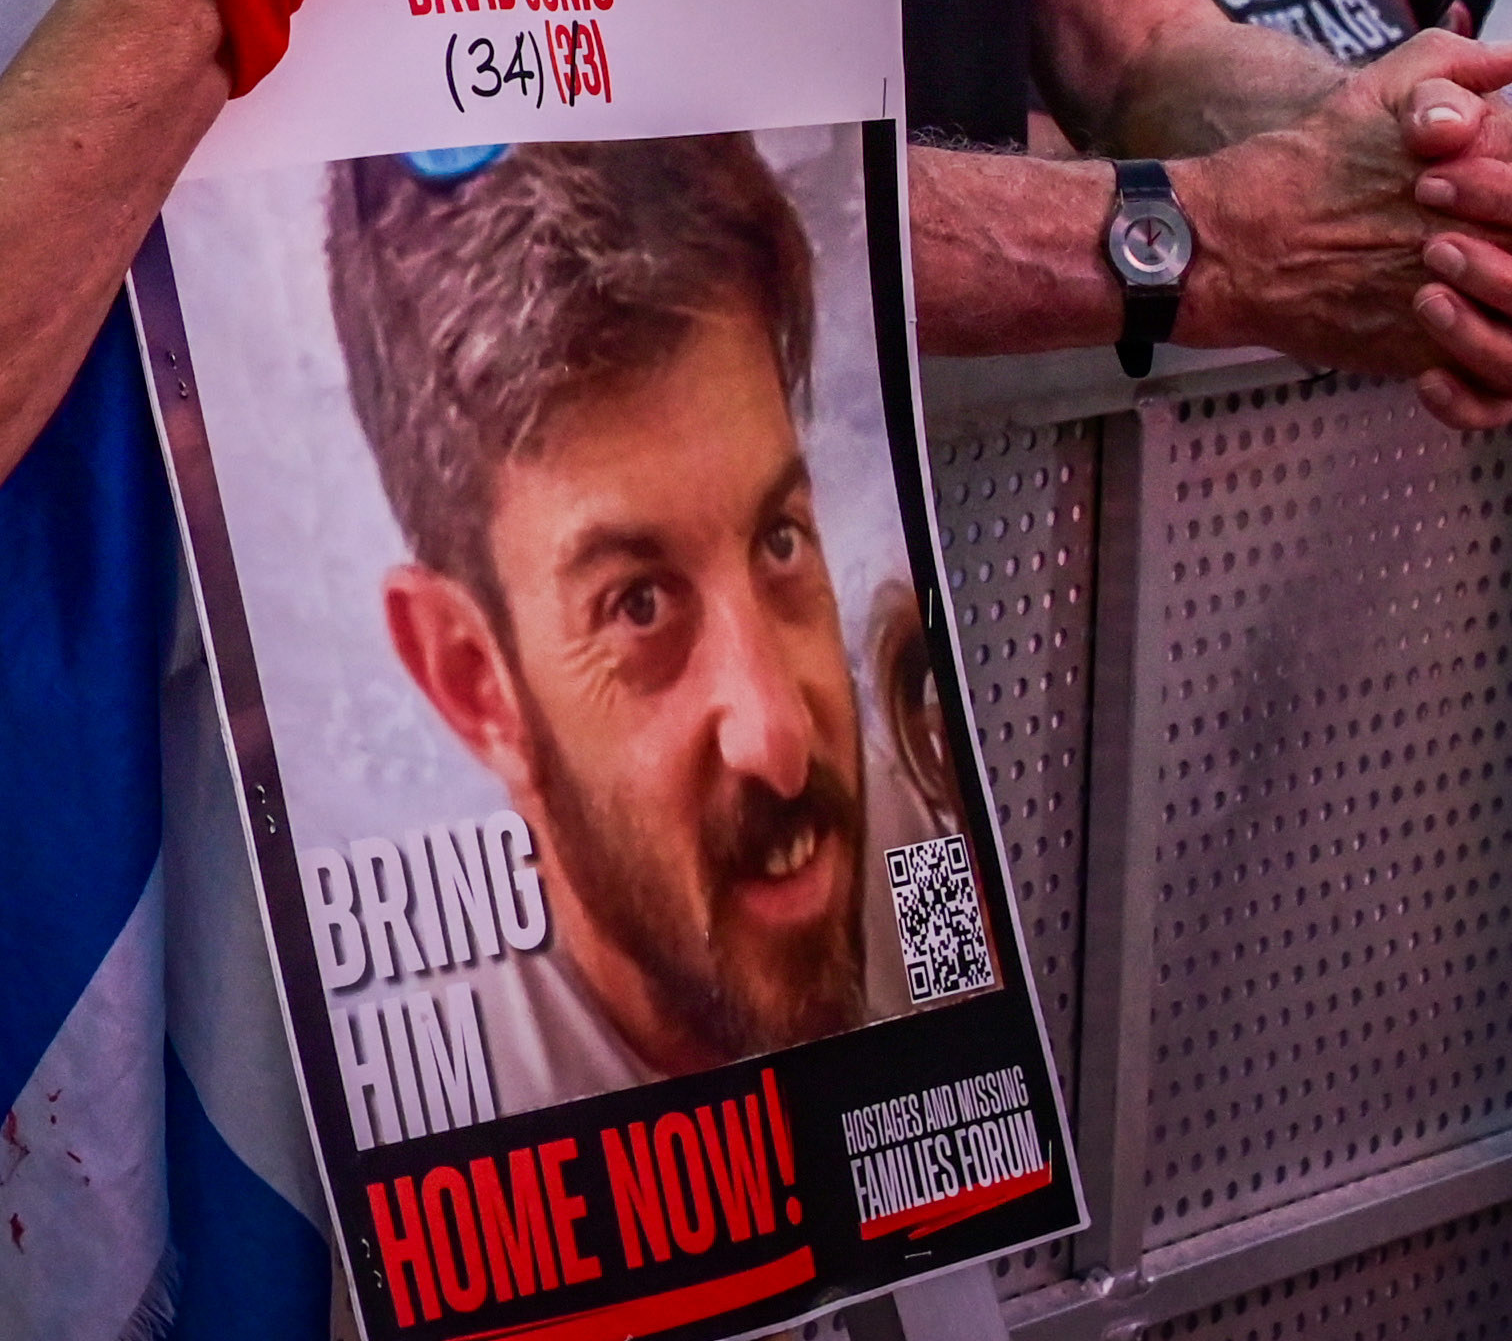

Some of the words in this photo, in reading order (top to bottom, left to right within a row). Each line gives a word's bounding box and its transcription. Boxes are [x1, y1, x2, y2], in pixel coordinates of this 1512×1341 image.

[445, 30, 544, 113] (34)
[298, 809, 549, 988] BRING
[330, 982, 494, 1151] HIM
[842, 1094, 923, 1156] HOSTAGES
[923, 1085, 958, 1132] AND
[955, 1065, 1029, 1121] MISSING
[367, 1138, 602, 1328] HOME
[601, 1068, 805, 1270] NOW!
[850, 1134, 960, 1223] FAMILIES
[955, 1110, 1044, 1192] FORUM
